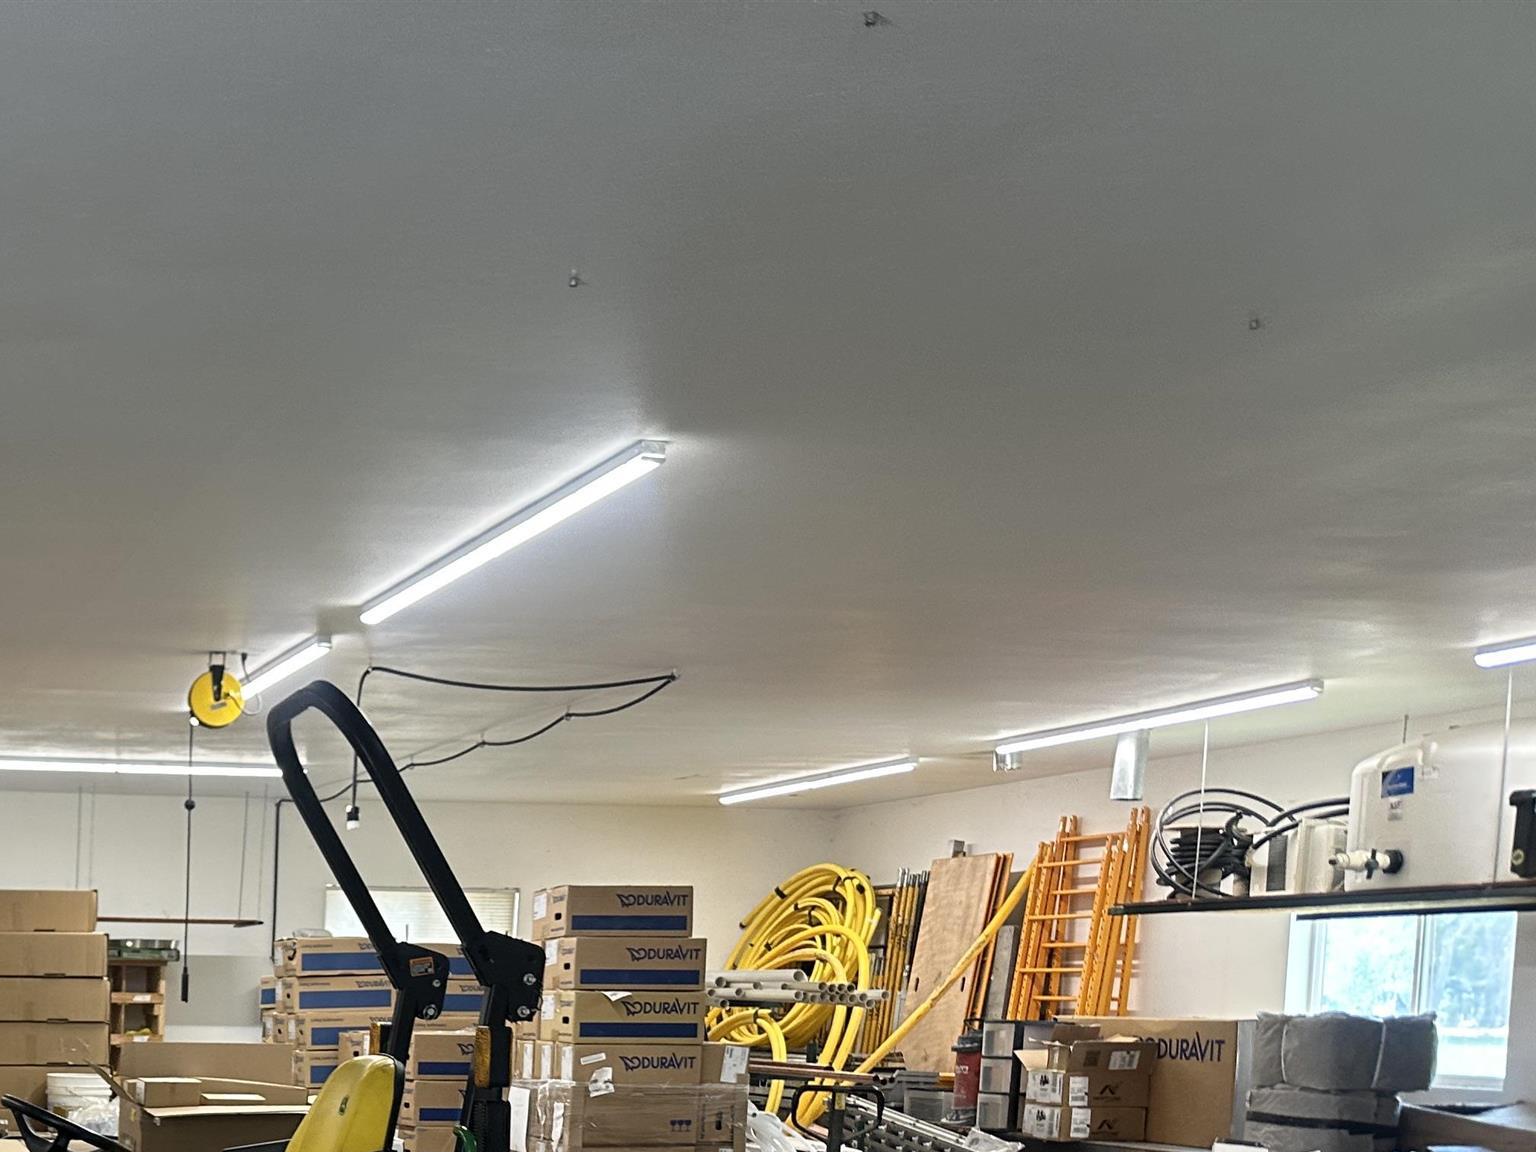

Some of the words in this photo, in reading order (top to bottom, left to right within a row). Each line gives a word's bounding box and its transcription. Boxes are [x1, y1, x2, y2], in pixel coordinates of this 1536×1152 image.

[636, 891, 689, 907] DURAVIT
[648, 945, 702, 961] DURAVIT
[644, 998, 700, 1014] DURAVIT
[1157, 1031, 1226, 1063] DURAVIT
[641, 1052, 696, 1069] DURAVIT
